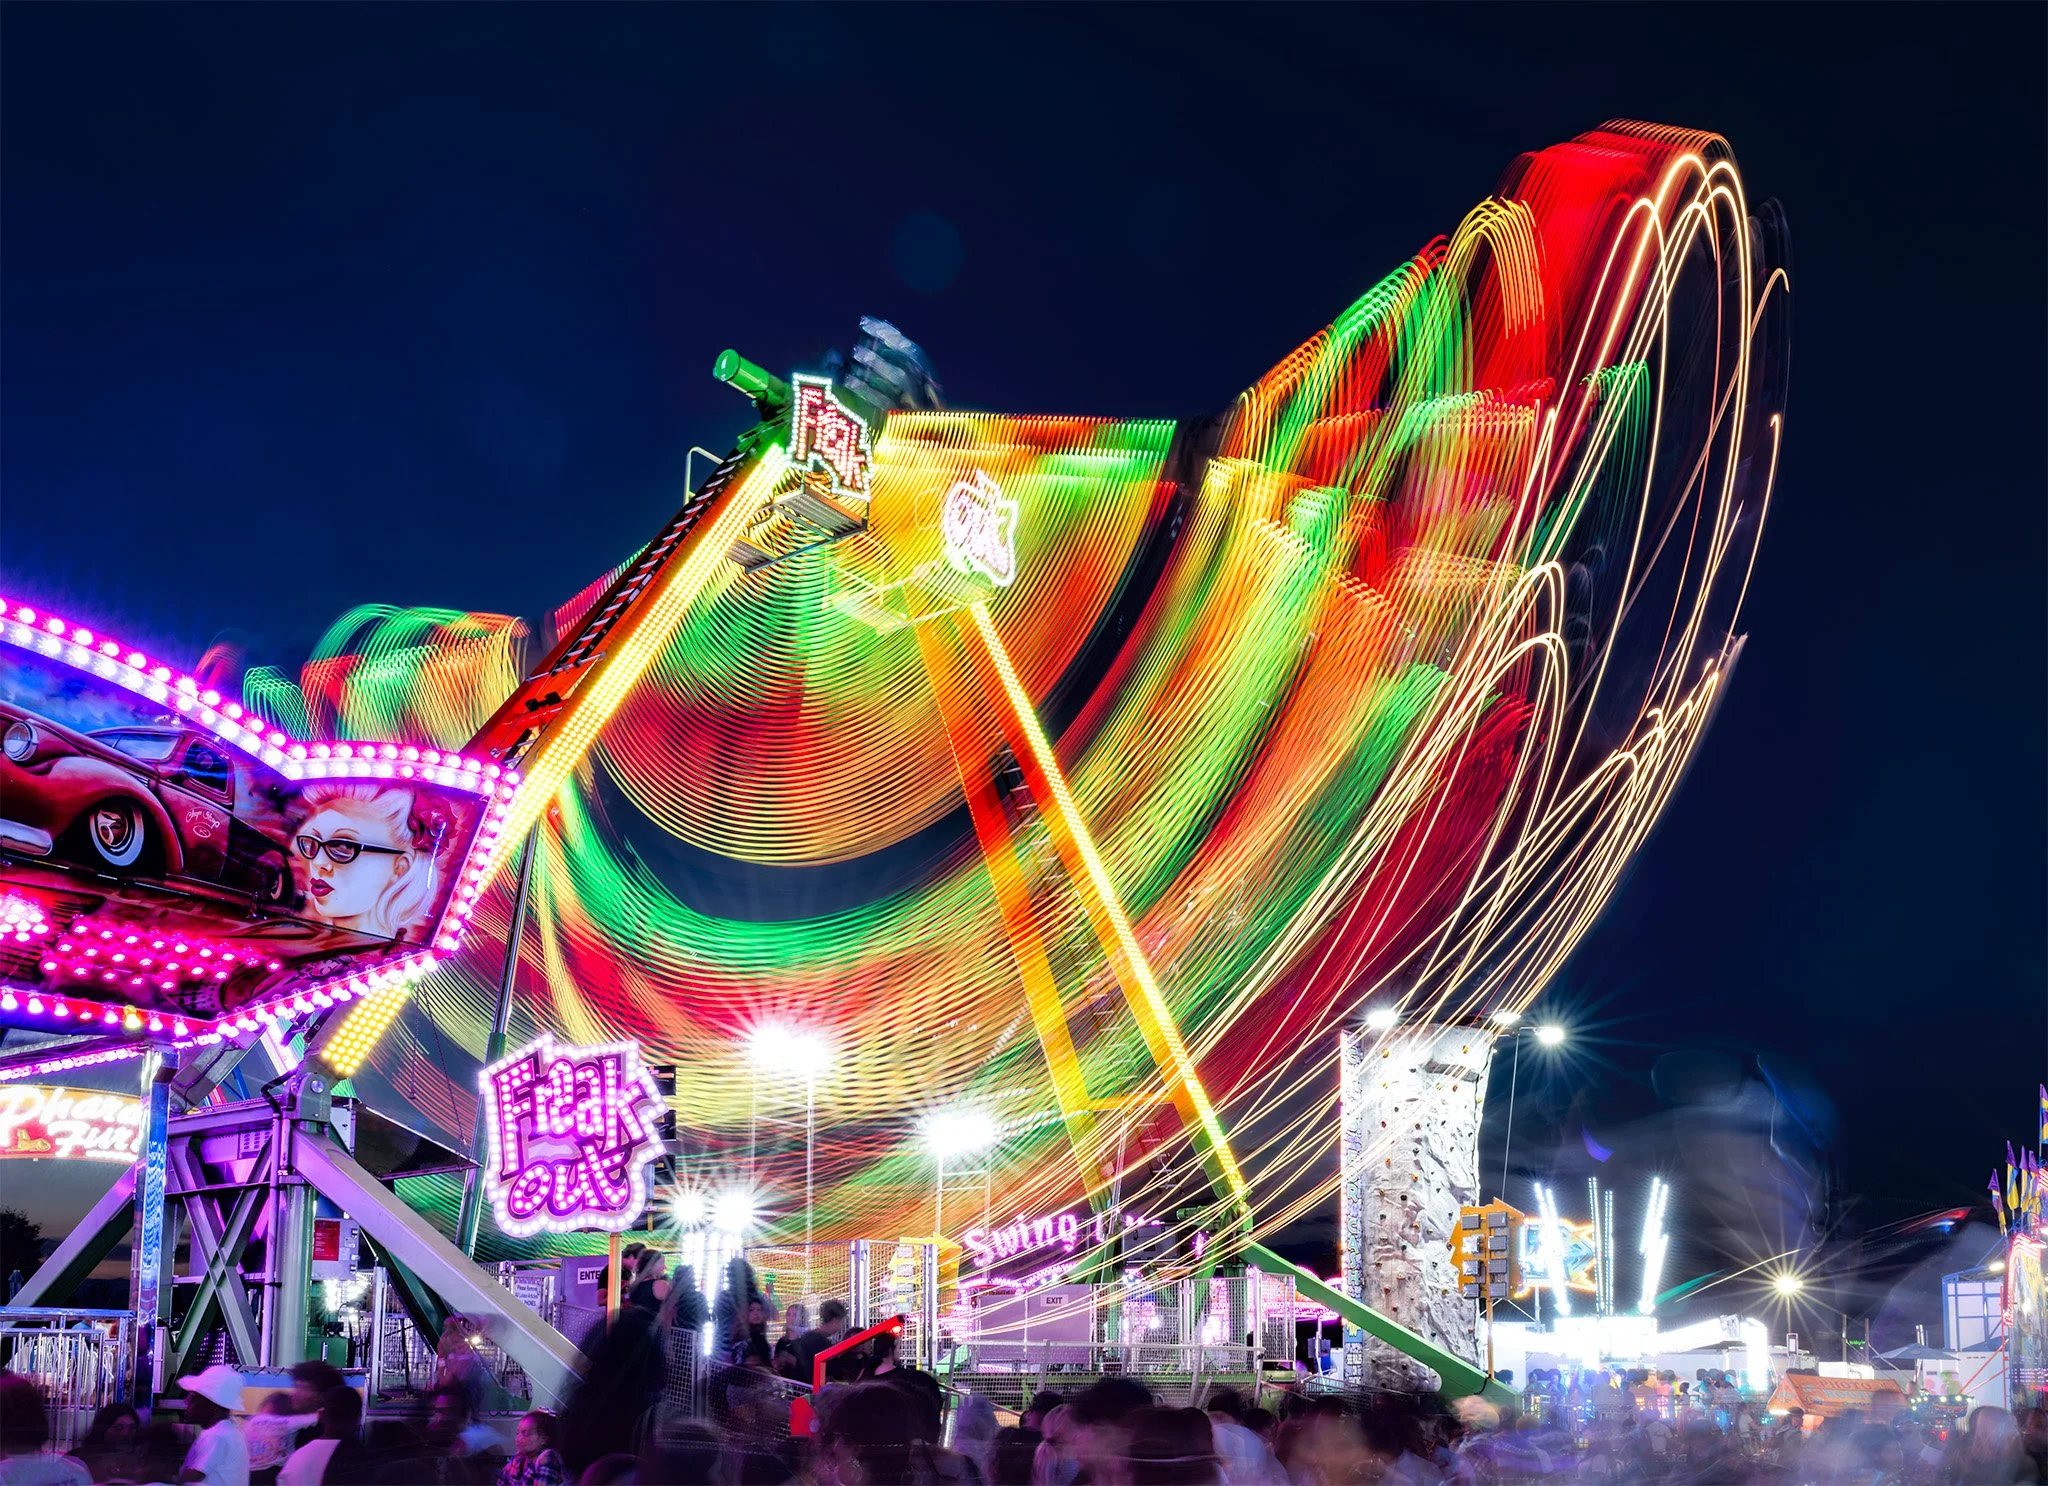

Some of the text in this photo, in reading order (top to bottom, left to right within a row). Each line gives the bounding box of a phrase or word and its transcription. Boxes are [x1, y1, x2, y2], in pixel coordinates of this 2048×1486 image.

[495, 1053, 645, 1178] Freak
[47, 1120, 141, 1157] Fur
[1347, 1219, 1360, 1286] CASH
[580, 1270, 601, 1281] ENTE
[1817, 1379, 1872, 1390] PHOTO
